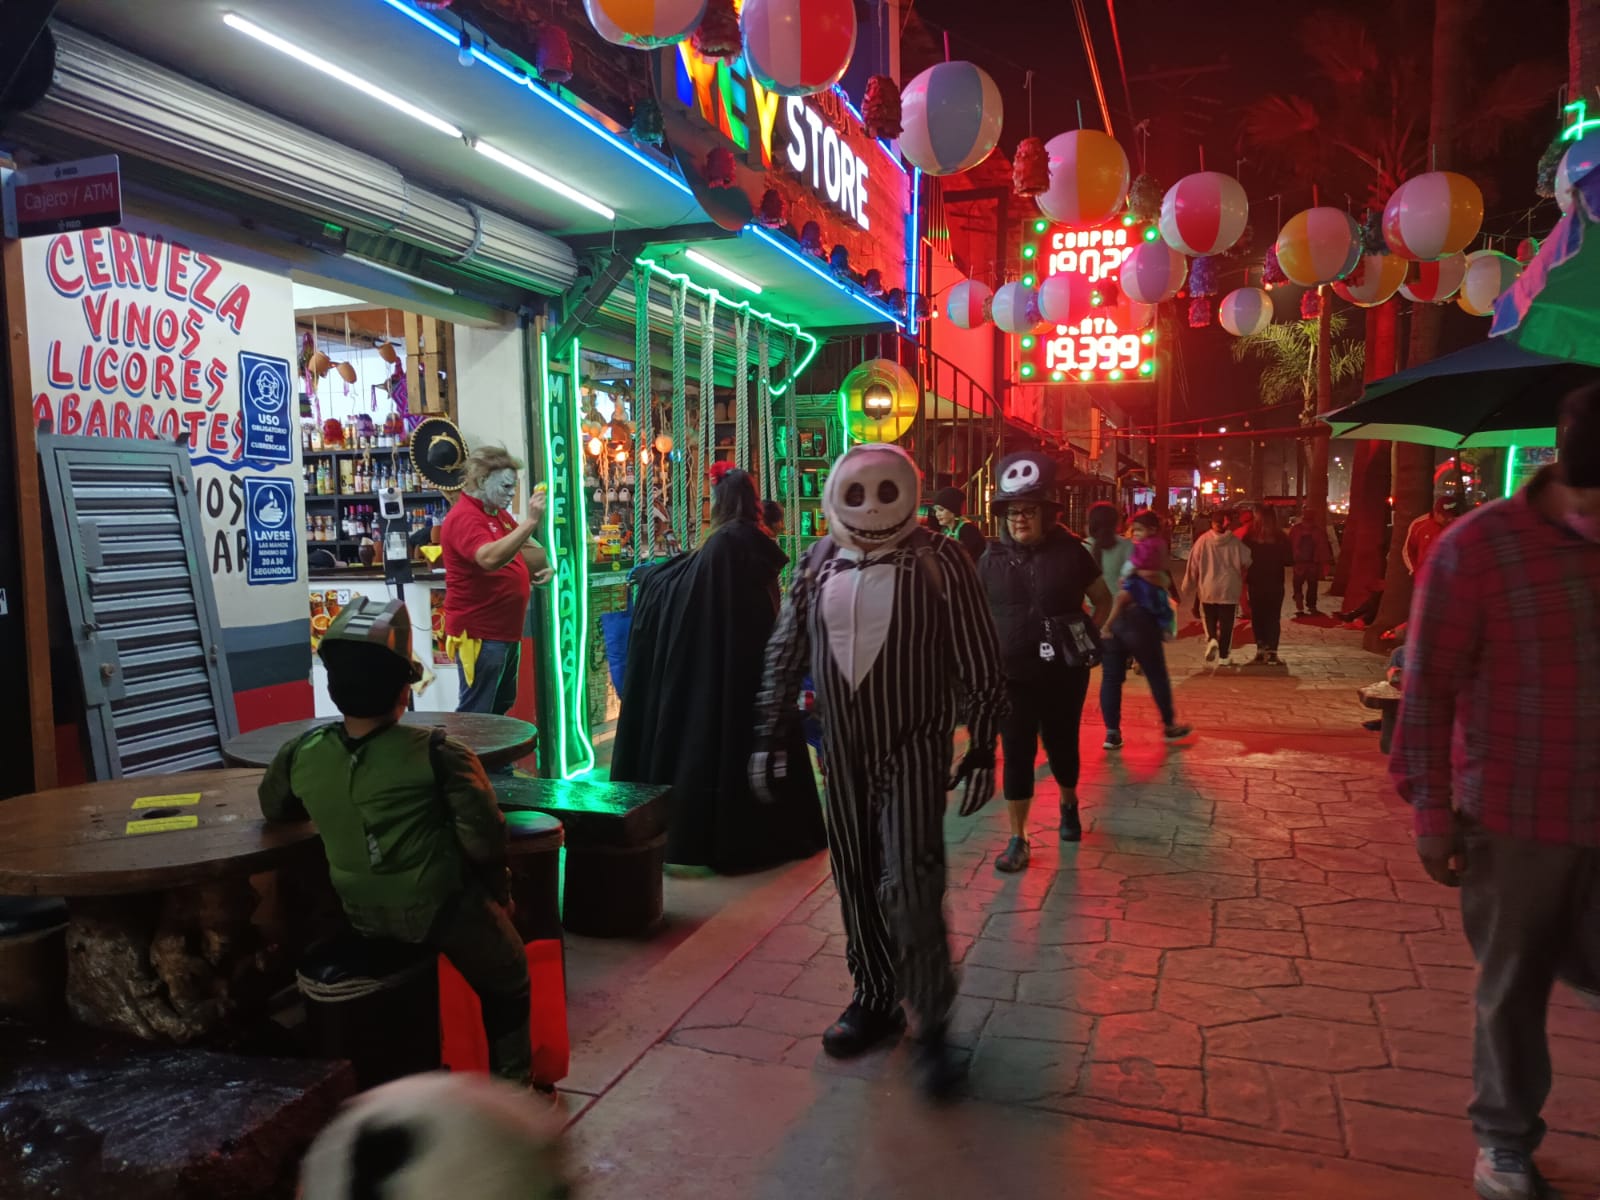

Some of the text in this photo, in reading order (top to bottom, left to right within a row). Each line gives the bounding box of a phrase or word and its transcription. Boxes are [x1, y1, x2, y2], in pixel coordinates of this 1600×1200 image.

[785, 93, 870, 231] STORE
[24, 182, 114, 213] Cajero / ATM
[1052, 229, 1127, 249] COMPRA
[46, 227, 250, 334] CERVEZA
[82, 291, 204, 358] VINOS
[1046, 334, 1140, 371] 19.399
[49, 340, 228, 409] LICORES
[32, 392, 245, 463] ABARROTES
[258, 413, 280, 426] USO
[264, 434, 274, 442] DE
[254, 530, 291, 541] LAVESE
[549, 373, 578, 694] MICHELADAS
[253, 566, 292, 576] SEGUNDOS
